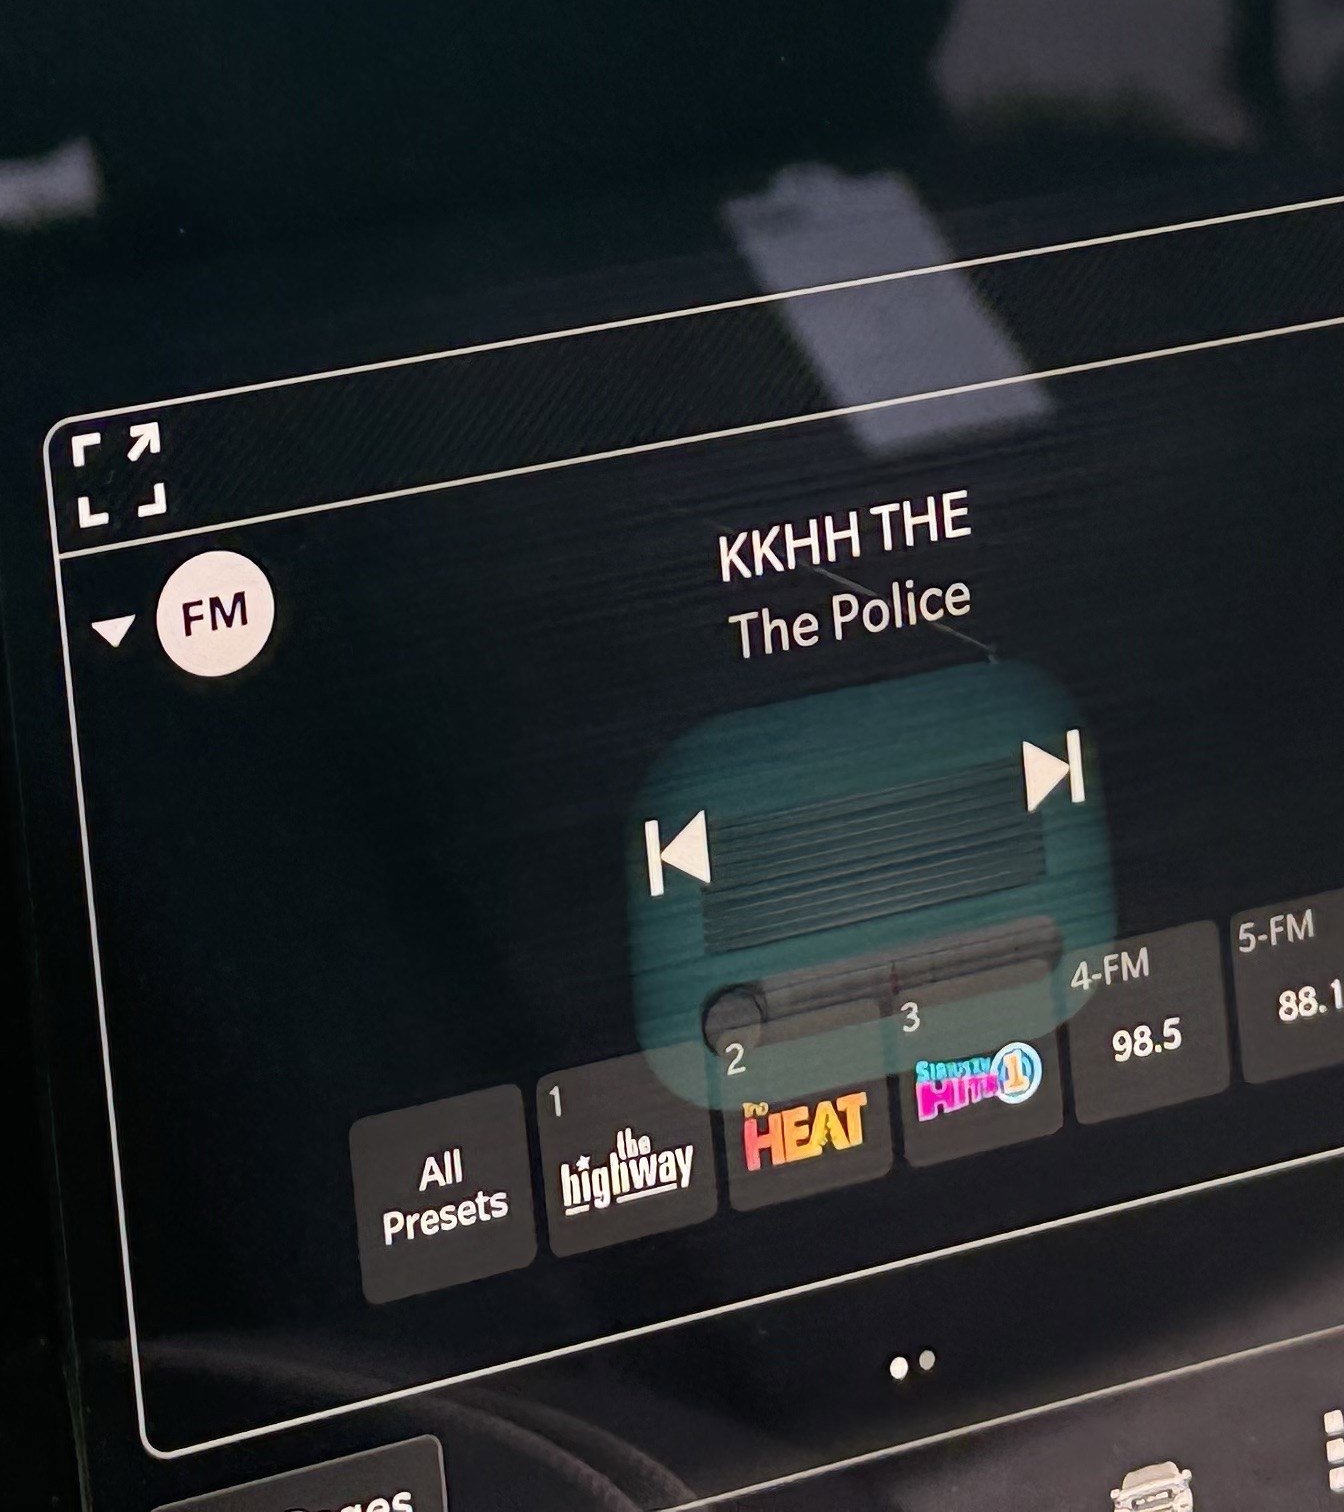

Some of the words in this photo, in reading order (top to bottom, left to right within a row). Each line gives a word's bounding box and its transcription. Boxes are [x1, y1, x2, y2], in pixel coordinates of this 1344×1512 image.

[717, 510, 862, 583] KKHH
[867, 489, 972, 553] THE
[182, 591, 248, 637] FM
[727, 608, 820, 661] The
[832, 578, 972, 643] Police
[1238, 909, 1315, 953] 5-FM
[1070, 947, 1150, 990] 4-FM
[901, 1001, 921, 1033] 3
[1278, 978, 1344, 1024] 88.1
[725, 1042, 747, 1076] 2
[1112, 1017, 1182, 1063] 98.5
[549, 1085, 562, 1117] 1
[616, 1127, 651, 1161] the
[744, 1091, 868, 1172] HEAT
[418, 1148, 464, 1192] All
[560, 1144, 694, 1209] highway
[381, 1189, 510, 1246] Presets
